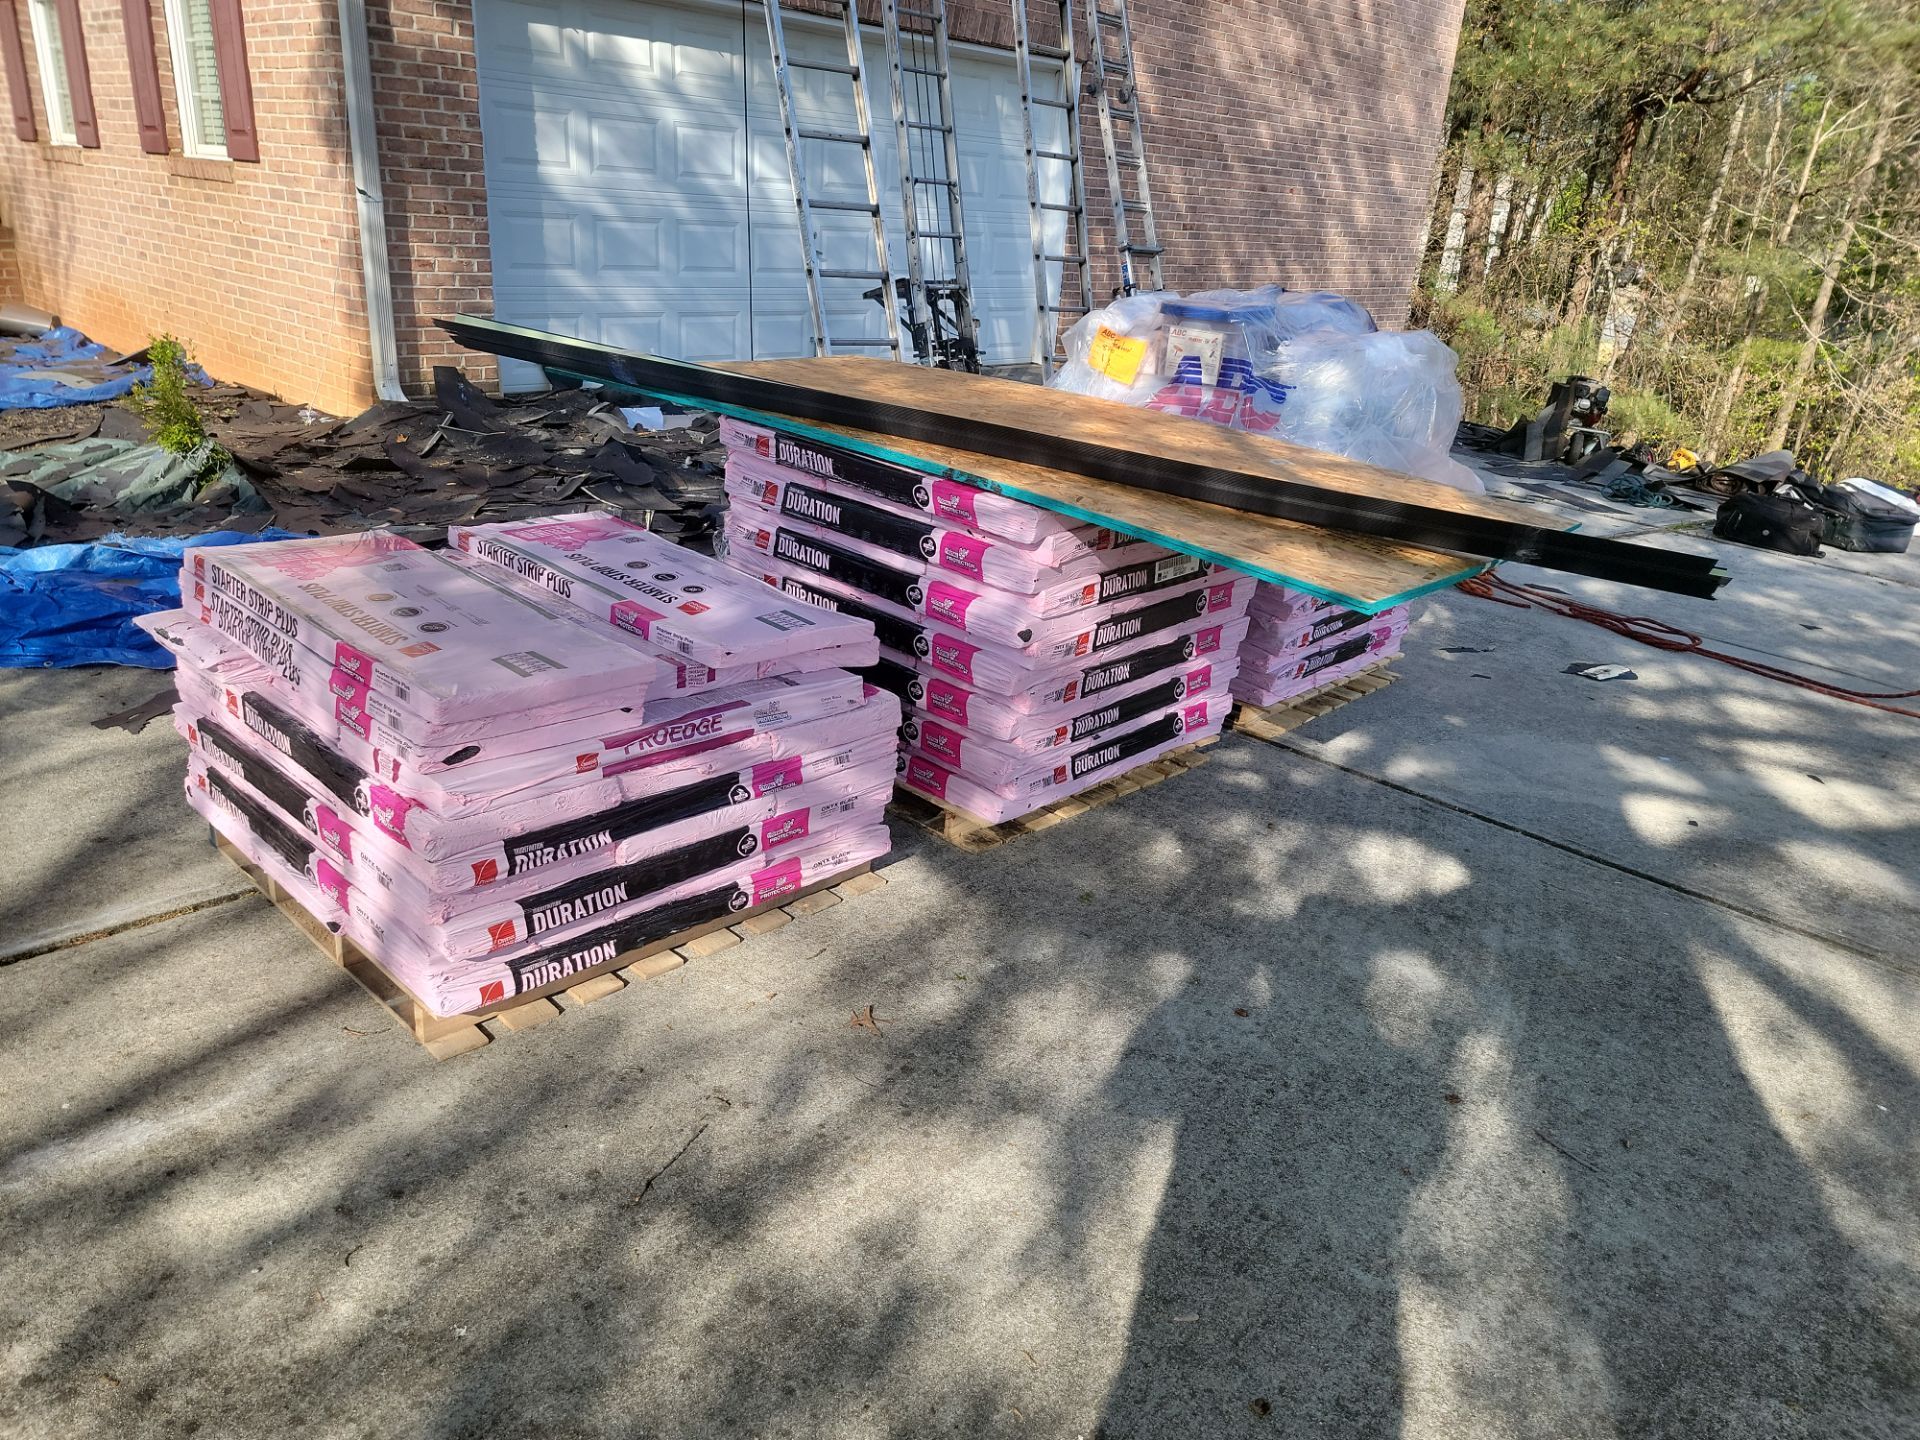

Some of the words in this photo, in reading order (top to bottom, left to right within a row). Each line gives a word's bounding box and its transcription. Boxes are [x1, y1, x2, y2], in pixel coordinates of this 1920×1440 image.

[1101, 329, 1116, 339] ABC
[779, 442, 834, 476] DURATION
[786, 492, 841, 525] DURATION
[564, 553, 599, 567] PLUS
[778, 537, 830, 570] DURATION
[477, 540, 517, 570] STARTER
[517, 557, 546, 583] STRIP
[546, 571, 575, 599] PLUS
[590, 562, 631, 581] STRIP
[1103, 569, 1148, 598] DURATION
[211, 564, 247, 603] STARTER
[248, 588, 274, 619] STRIP
[275, 606, 298, 639] PLUS
[302, 582, 332, 600] PLUS
[321, 594, 363, 618] STRIP
[623, 578, 679, 604] STARTER
[785, 584, 837, 612] DURATION
[350, 614, 409, 646] STARTER
[1096, 617, 1142, 647] DURATION
[1084, 663, 1130, 693] DURATION
[245, 708, 292, 757] DURATION
[623, 713, 723, 755] PROEDGE
[1075, 706, 1120, 737] DURATION
[1074, 744, 1120, 775] DURATION
[821, 803, 838, 812] ONYX
[839, 795, 858, 806] BLACK
[769, 827, 802, 844] PROTECTION
[515, 830, 613, 875] DURATION
[813, 858, 830, 869] ONYX
[831, 851, 851, 861] BLACK
[760, 883, 794, 899] PROTECTION
[532, 882, 629, 934] DURATION
[521, 940, 617, 993] DURATION
